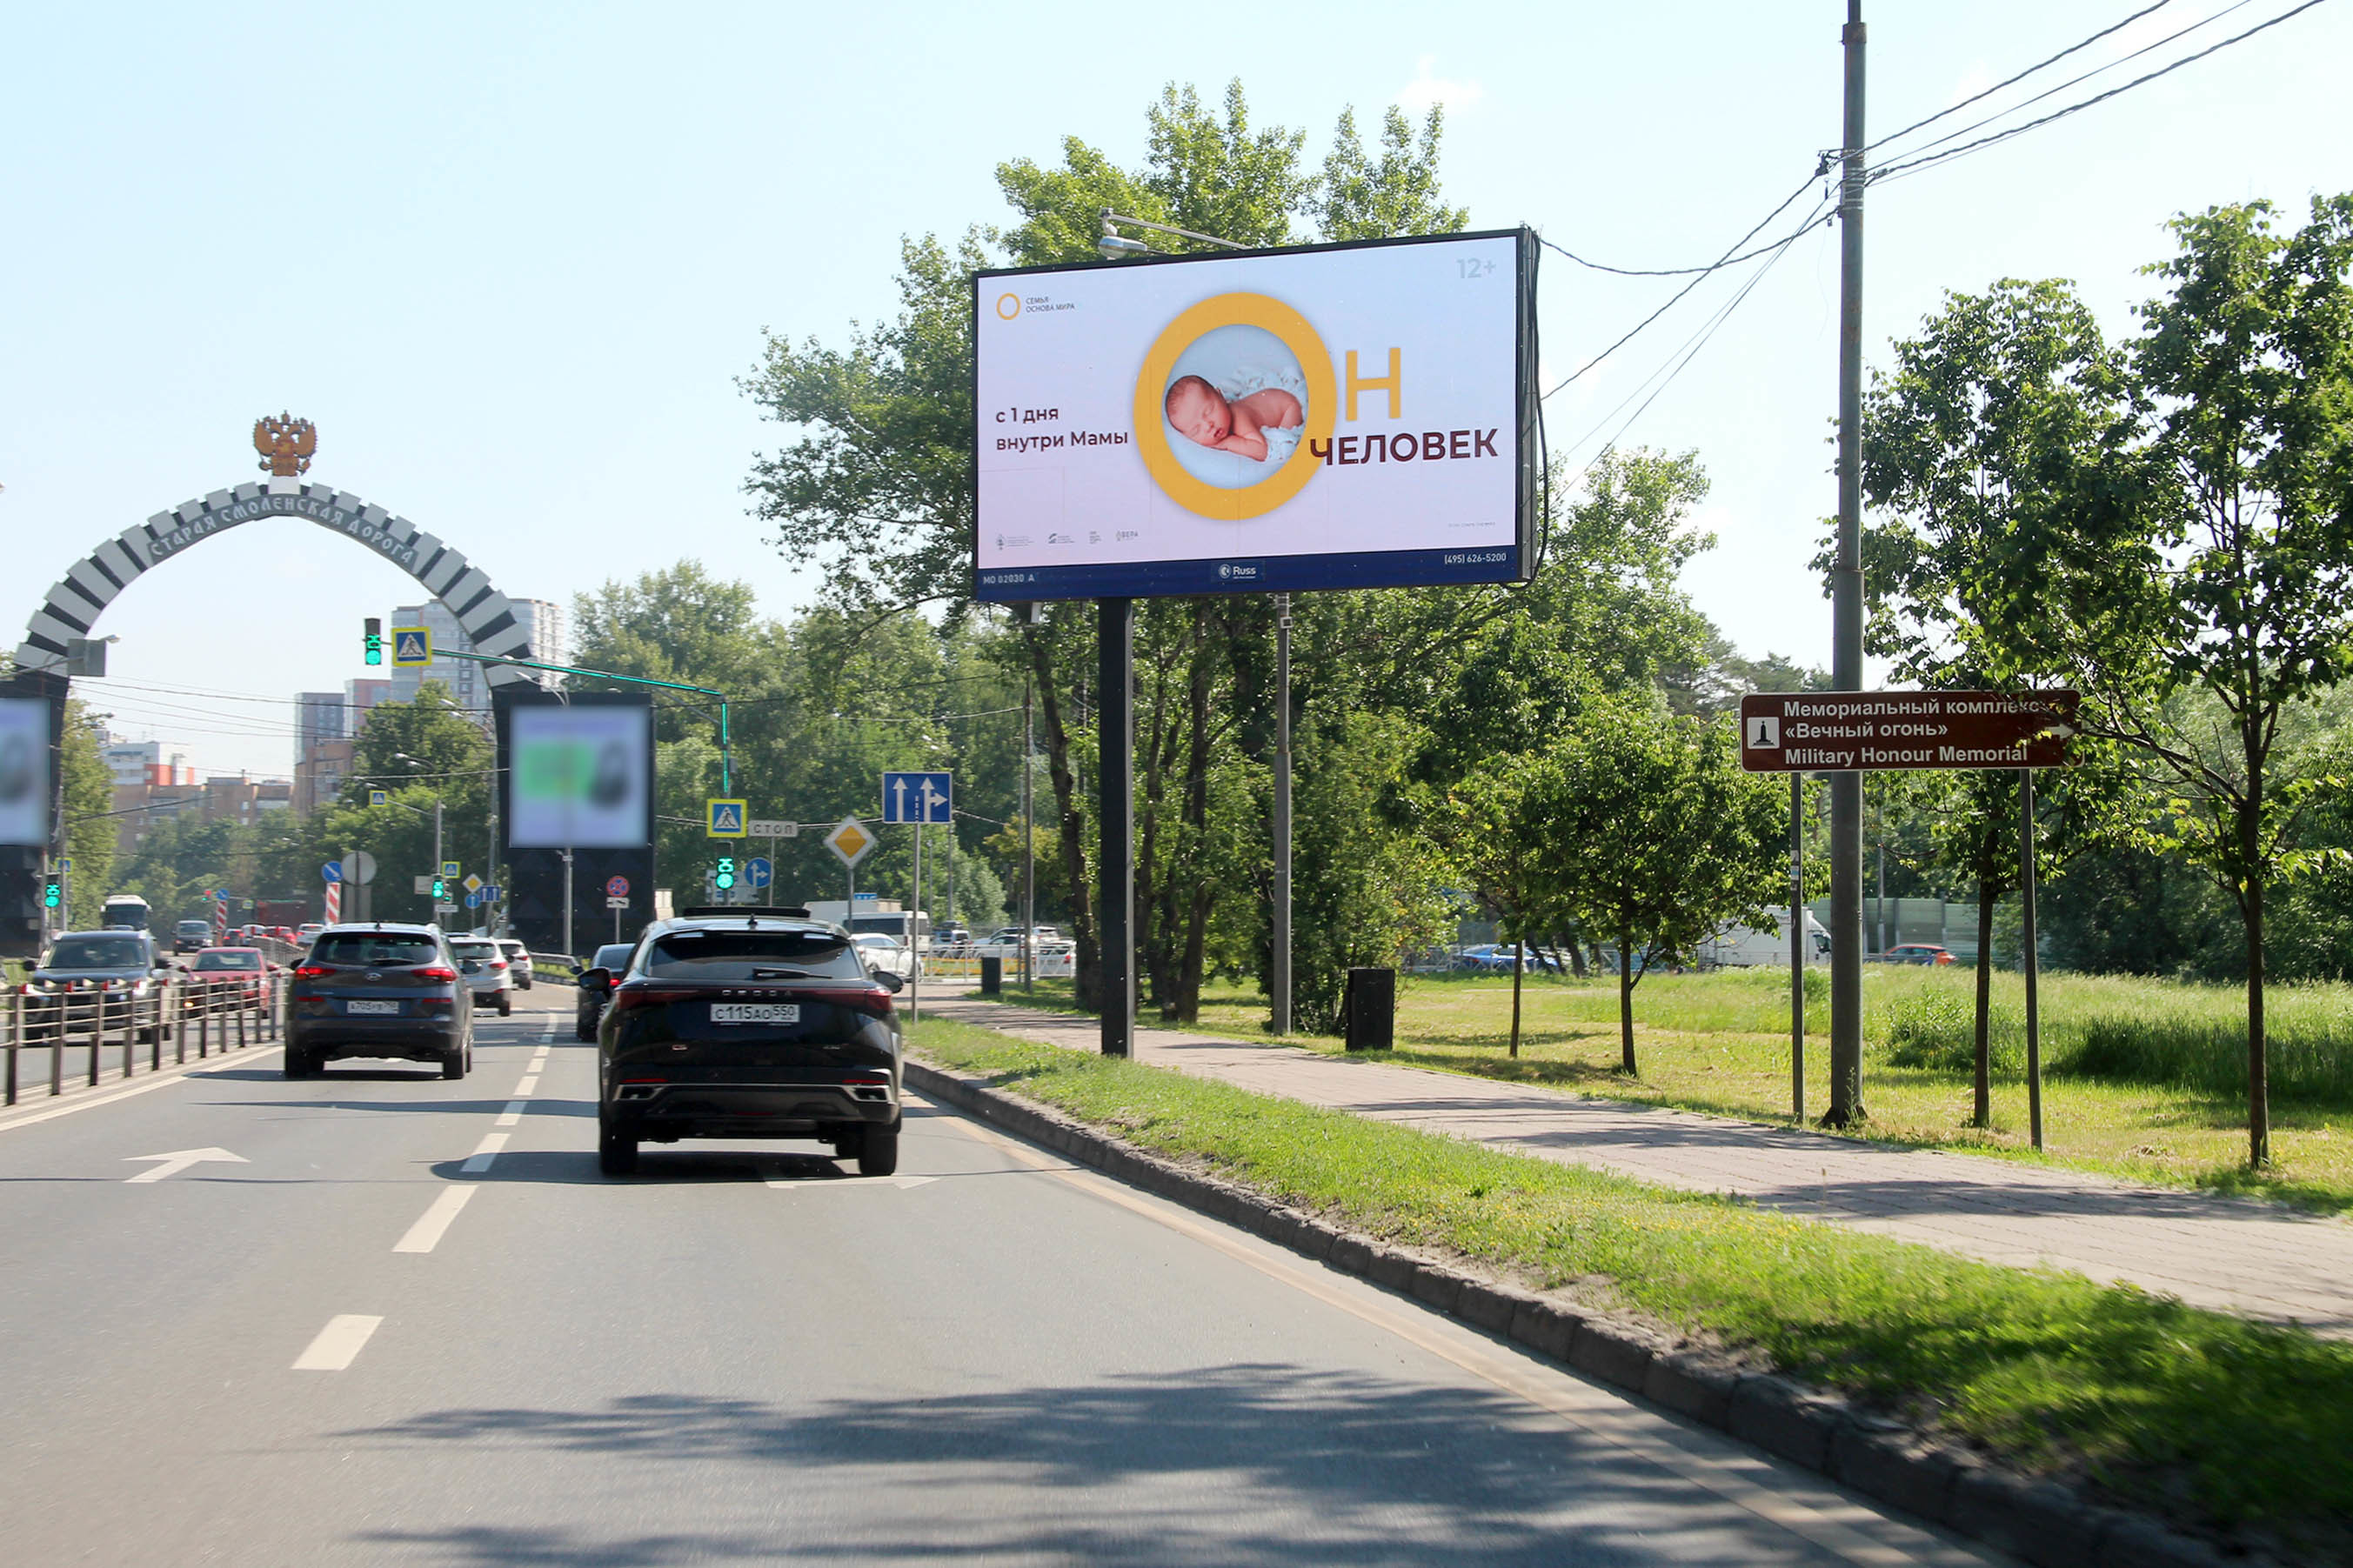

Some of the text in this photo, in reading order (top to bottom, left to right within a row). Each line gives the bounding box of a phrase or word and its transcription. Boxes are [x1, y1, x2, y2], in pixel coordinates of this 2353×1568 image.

[1456, 257, 1496, 278] 12+
[1026, 304, 1054, 313] ОСНОВА
[995, 407, 1059, 424] с 1 дня
[996, 430, 1128, 453] внутри Мамы
[1309, 428, 1499, 465] ЧЕЛОВЕК
[150, 497, 414, 564] СТАРАЯ СМОЛЕНСКАЯ ДОРОГА
[1444, 552, 1507, 564] (495) 626-5200
[1233, 565, 1257, 575] Russ
[1784, 697, 1940, 720] Мемориальный
[1785, 721, 1949, 738] «Вечный огонь»
[1785, 745, 2028, 767] Military Honour Memorial
[753, 823, 793, 835] СТОП
